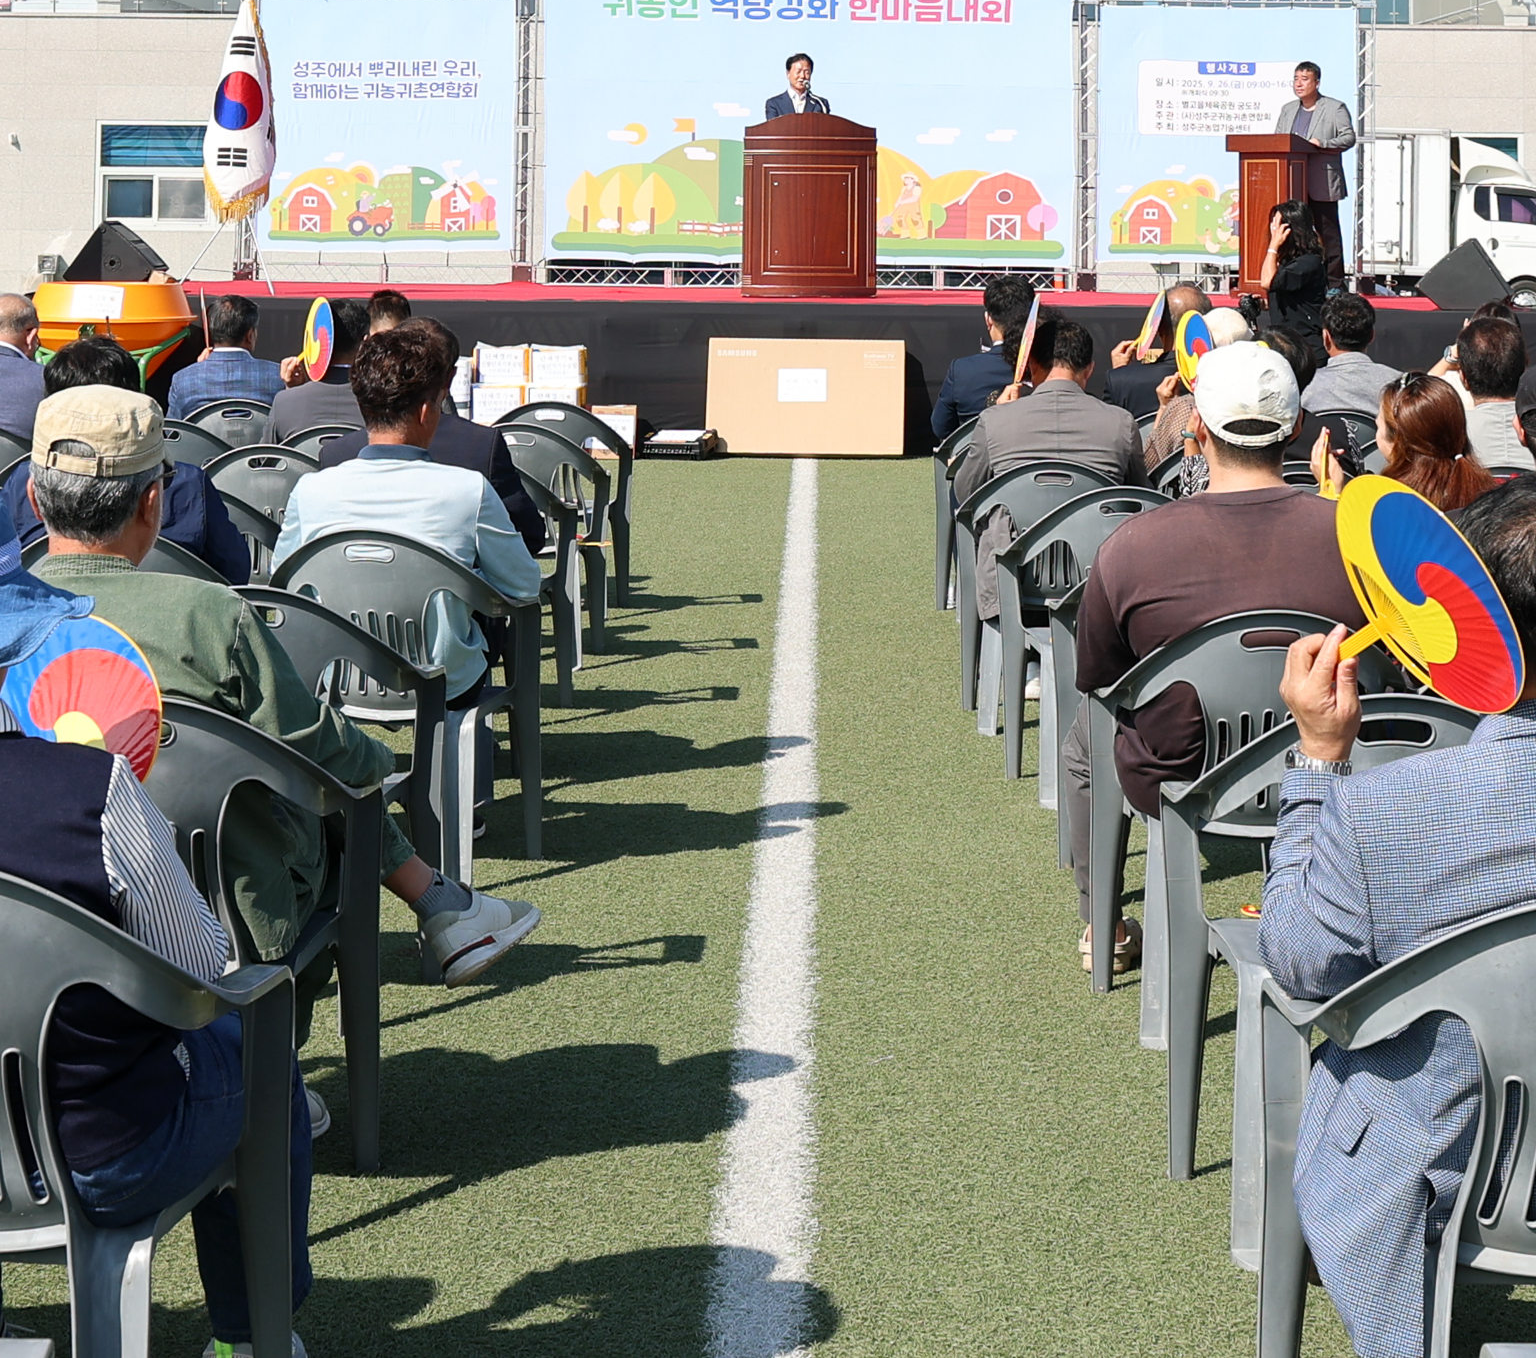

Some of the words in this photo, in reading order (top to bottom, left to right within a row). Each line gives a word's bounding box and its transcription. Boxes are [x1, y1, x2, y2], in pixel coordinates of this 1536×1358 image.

[292, 60, 362, 78] 성주에서
[368, 60, 438, 78] 뿌리내린
[443, 59, 482, 79] 우리,
[1205, 63, 1250, 74] 행사개요
[1181, 79, 1205, 88] 2025.
[292, 82, 359, 100] 함께하는
[363, 81, 478, 99] 귀농귀촌연합회
[1181, 101, 1235, 110] 별고을체육공원
[1181, 122, 1251, 133] 성주군농업기술센터
[716, 349, 758, 357] SAMSUNG
